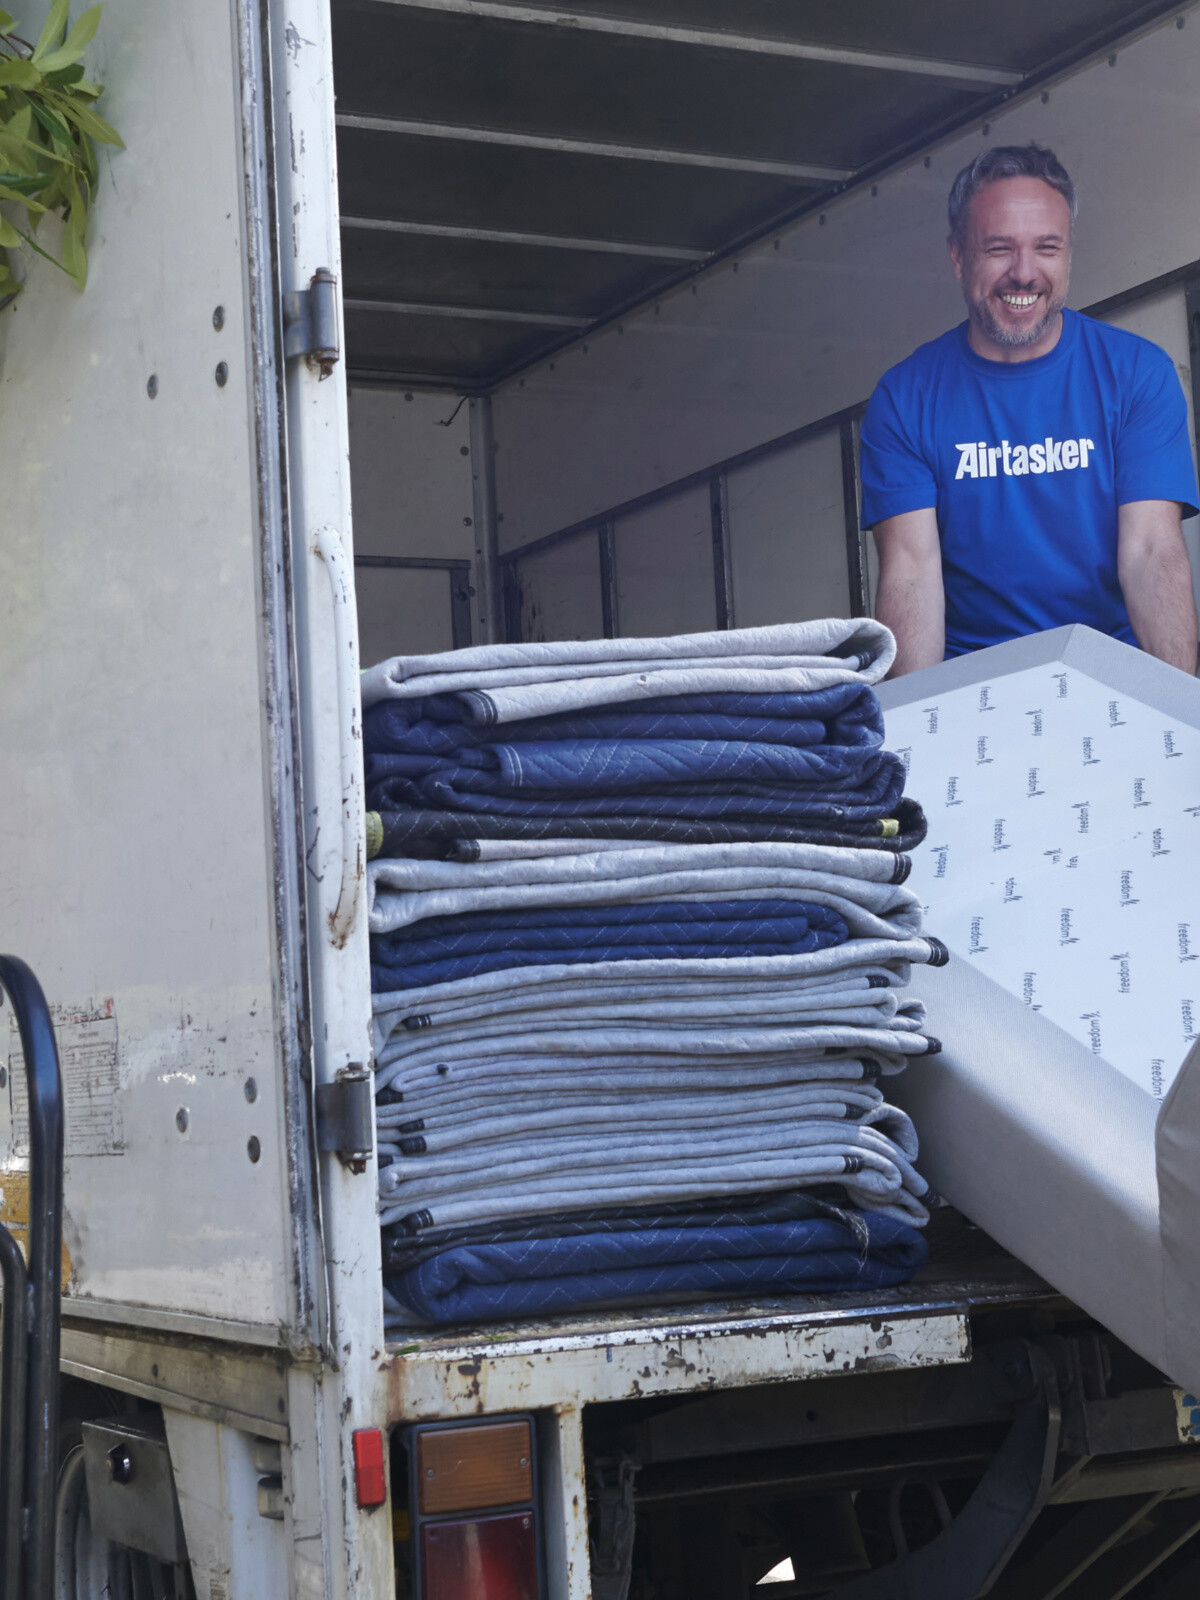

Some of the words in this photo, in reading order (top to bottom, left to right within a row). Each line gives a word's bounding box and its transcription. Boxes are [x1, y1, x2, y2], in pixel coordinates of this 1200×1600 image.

[955, 437, 1095, 480] Airtasker
[980, 686, 991, 707] freedom
[1057, 677, 1068, 698] freedom
[927, 712, 938, 734] freedom
[1109, 701, 1120, 722] freedom
[1032, 714, 1042, 736] freedom
[978, 736, 989, 760] freedom
[1083, 737, 1094, 760] freedom
[1164, 731, 1174, 754] freedom
[947, 777, 960, 801] freedom
[1029, 768, 1040, 793] freedom
[1134, 778, 1146, 803] freedom
[994, 819, 1006, 846] freedom
[1078, 808, 1090, 834] freedom
[934, 850, 948, 878] freedom
[1121, 870, 1133, 900] freedom
[971, 916, 984, 948] freedom
[1061, 908, 1074, 939] freedom
[1178, 923, 1190, 955] freedom
[1024, 972, 1036, 1006] freedom
[1119, 961, 1130, 994] freedom
[1181, 1000, 1194, 1034] freedom
[1152, 1059, 1164, 1096] freedom
